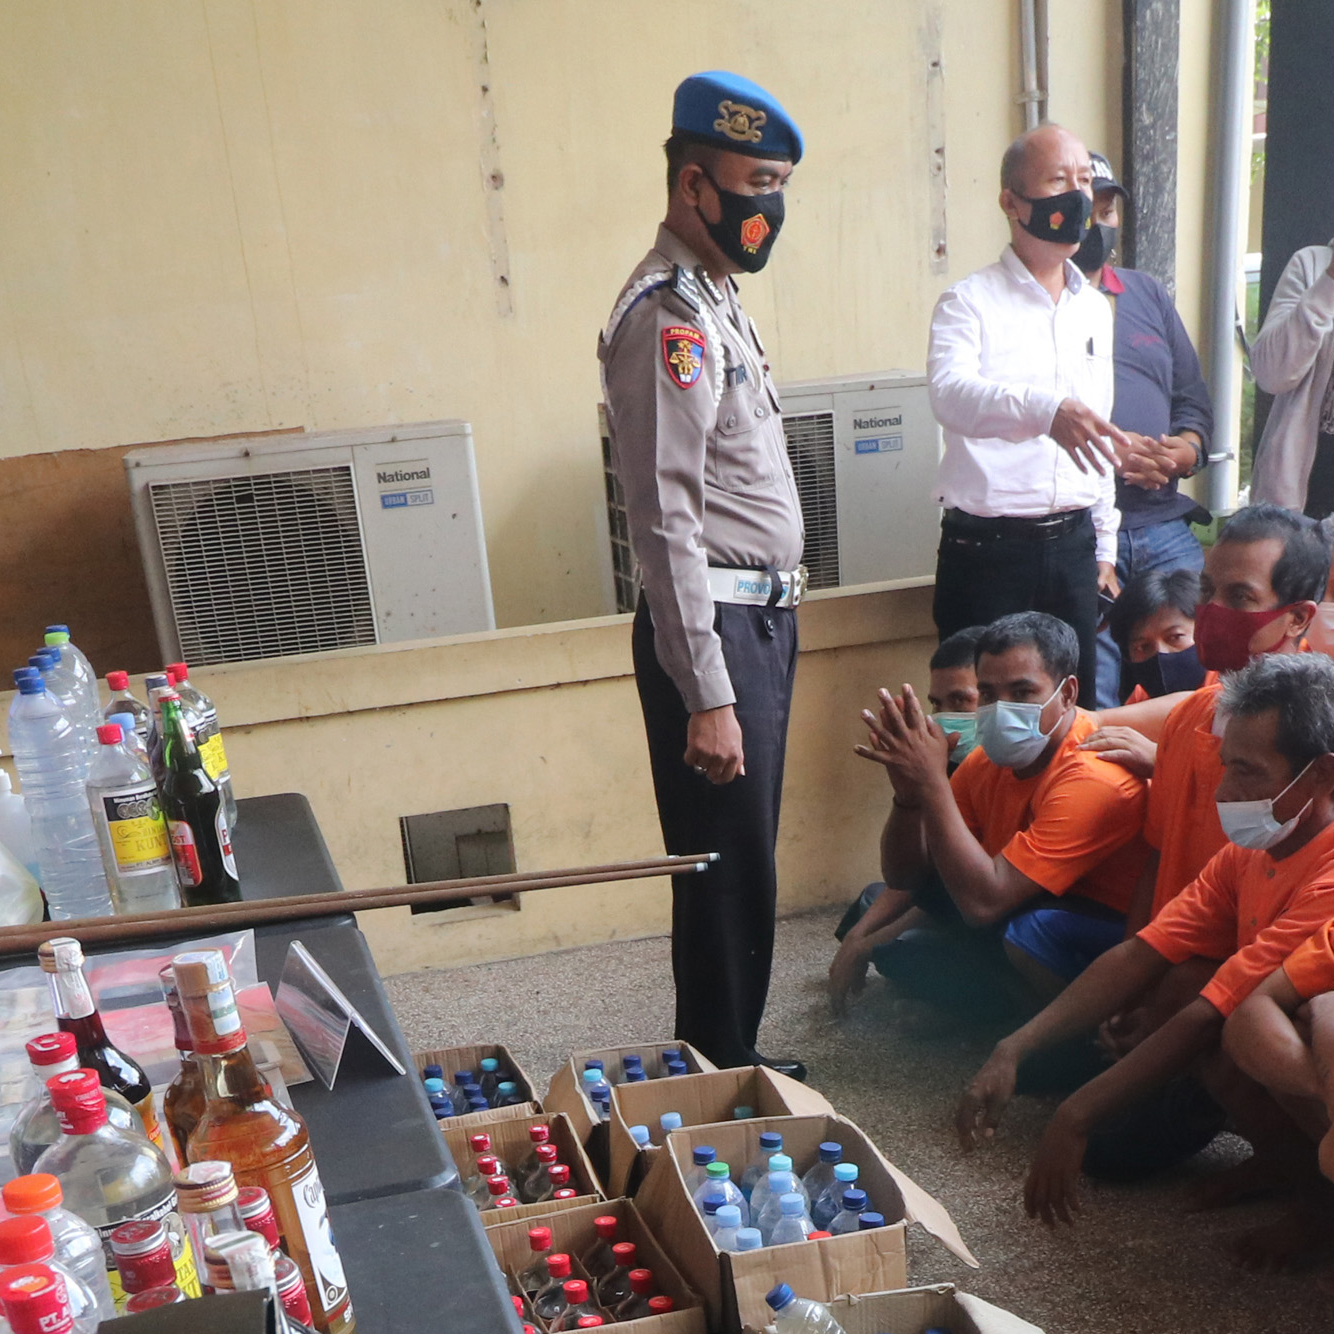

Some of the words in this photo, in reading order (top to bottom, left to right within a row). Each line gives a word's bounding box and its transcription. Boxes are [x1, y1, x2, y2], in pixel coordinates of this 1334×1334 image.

[669, 328, 701, 341] PROPAM
[853, 414, 902, 430] National
[376, 467, 431, 484] National
[736, 580, 771, 595] PROVO
